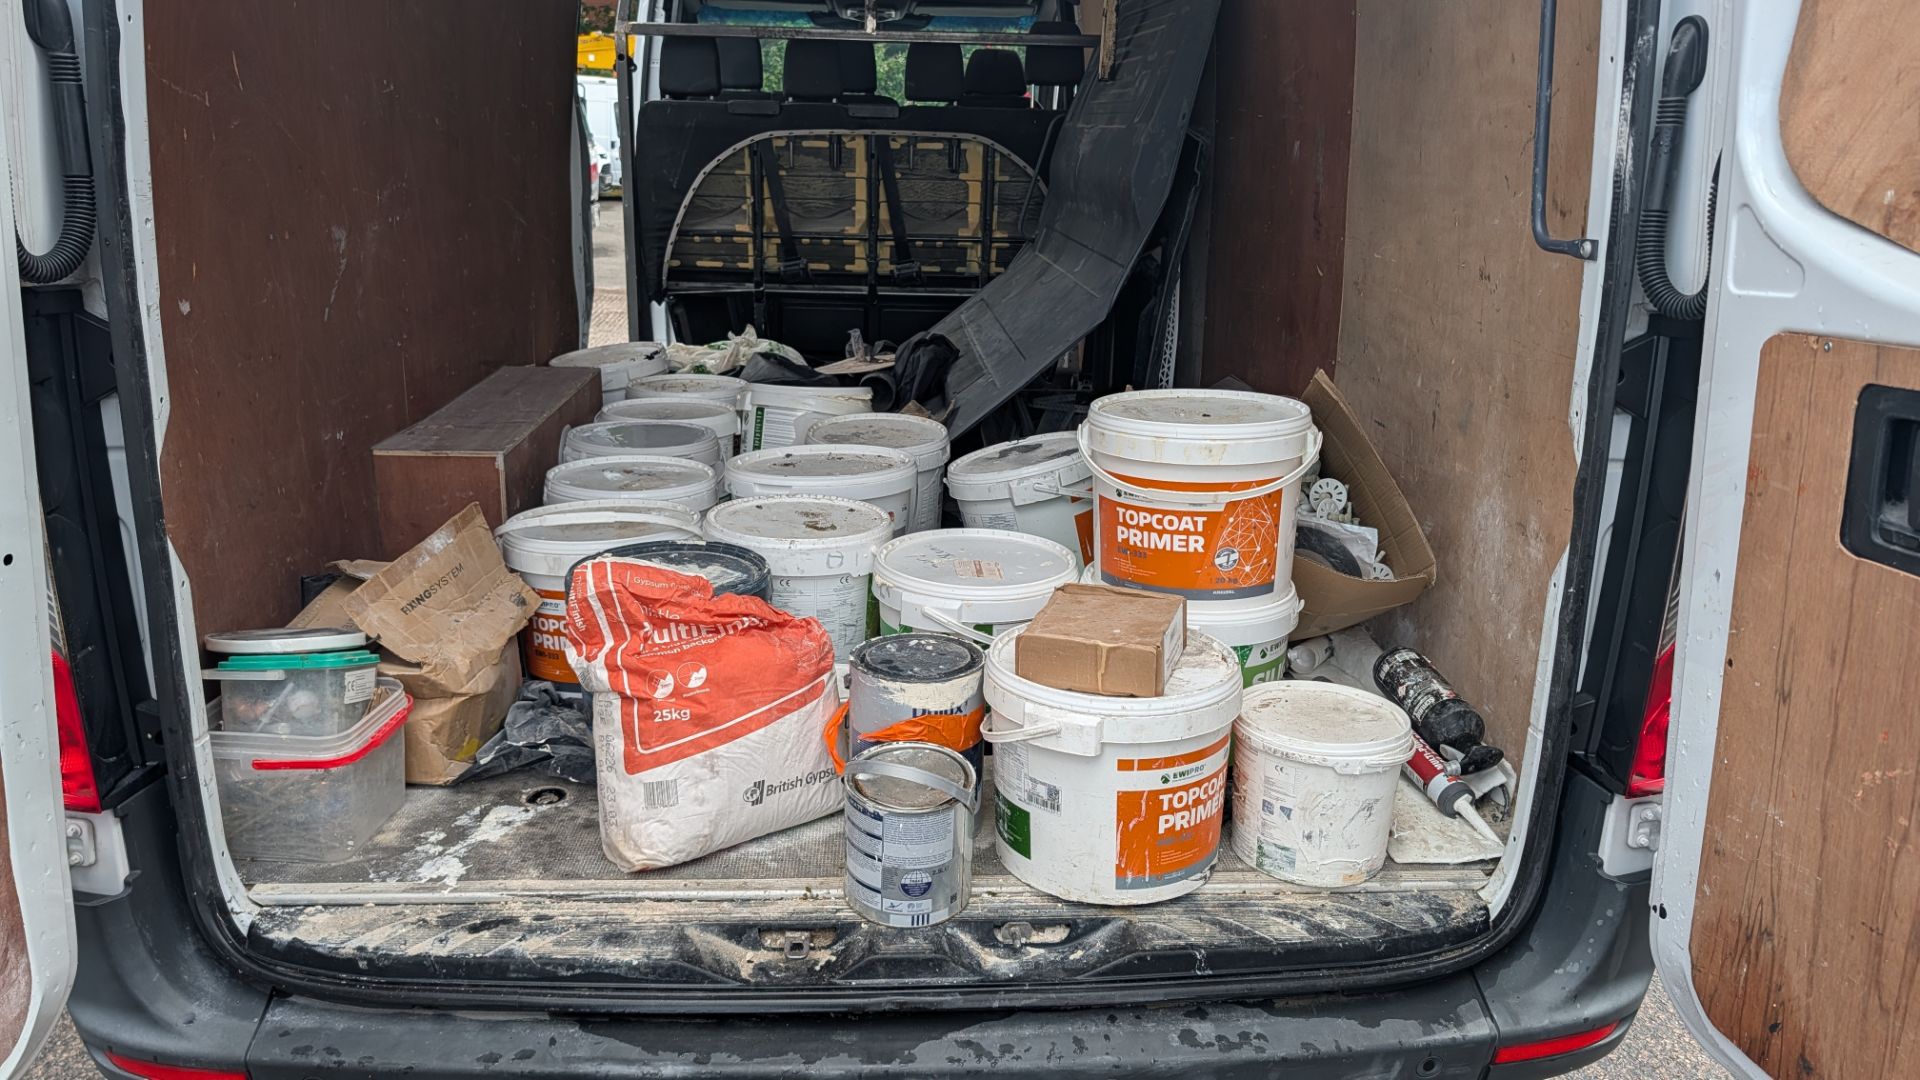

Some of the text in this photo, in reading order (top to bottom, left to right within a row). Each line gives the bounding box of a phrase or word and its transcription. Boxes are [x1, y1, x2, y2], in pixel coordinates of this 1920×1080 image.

[1116, 506, 1208, 532] TOPCOAT
[1117, 525, 1206, 553] PRIMER
[633, 576, 669, 590] Gypsum
[531, 616, 569, 634] TOPC
[533, 631, 569, 651] PRIM
[653, 708, 691, 723] 25kg
[765, 775, 803, 797] British
[805, 767, 837, 786] Gypsu
